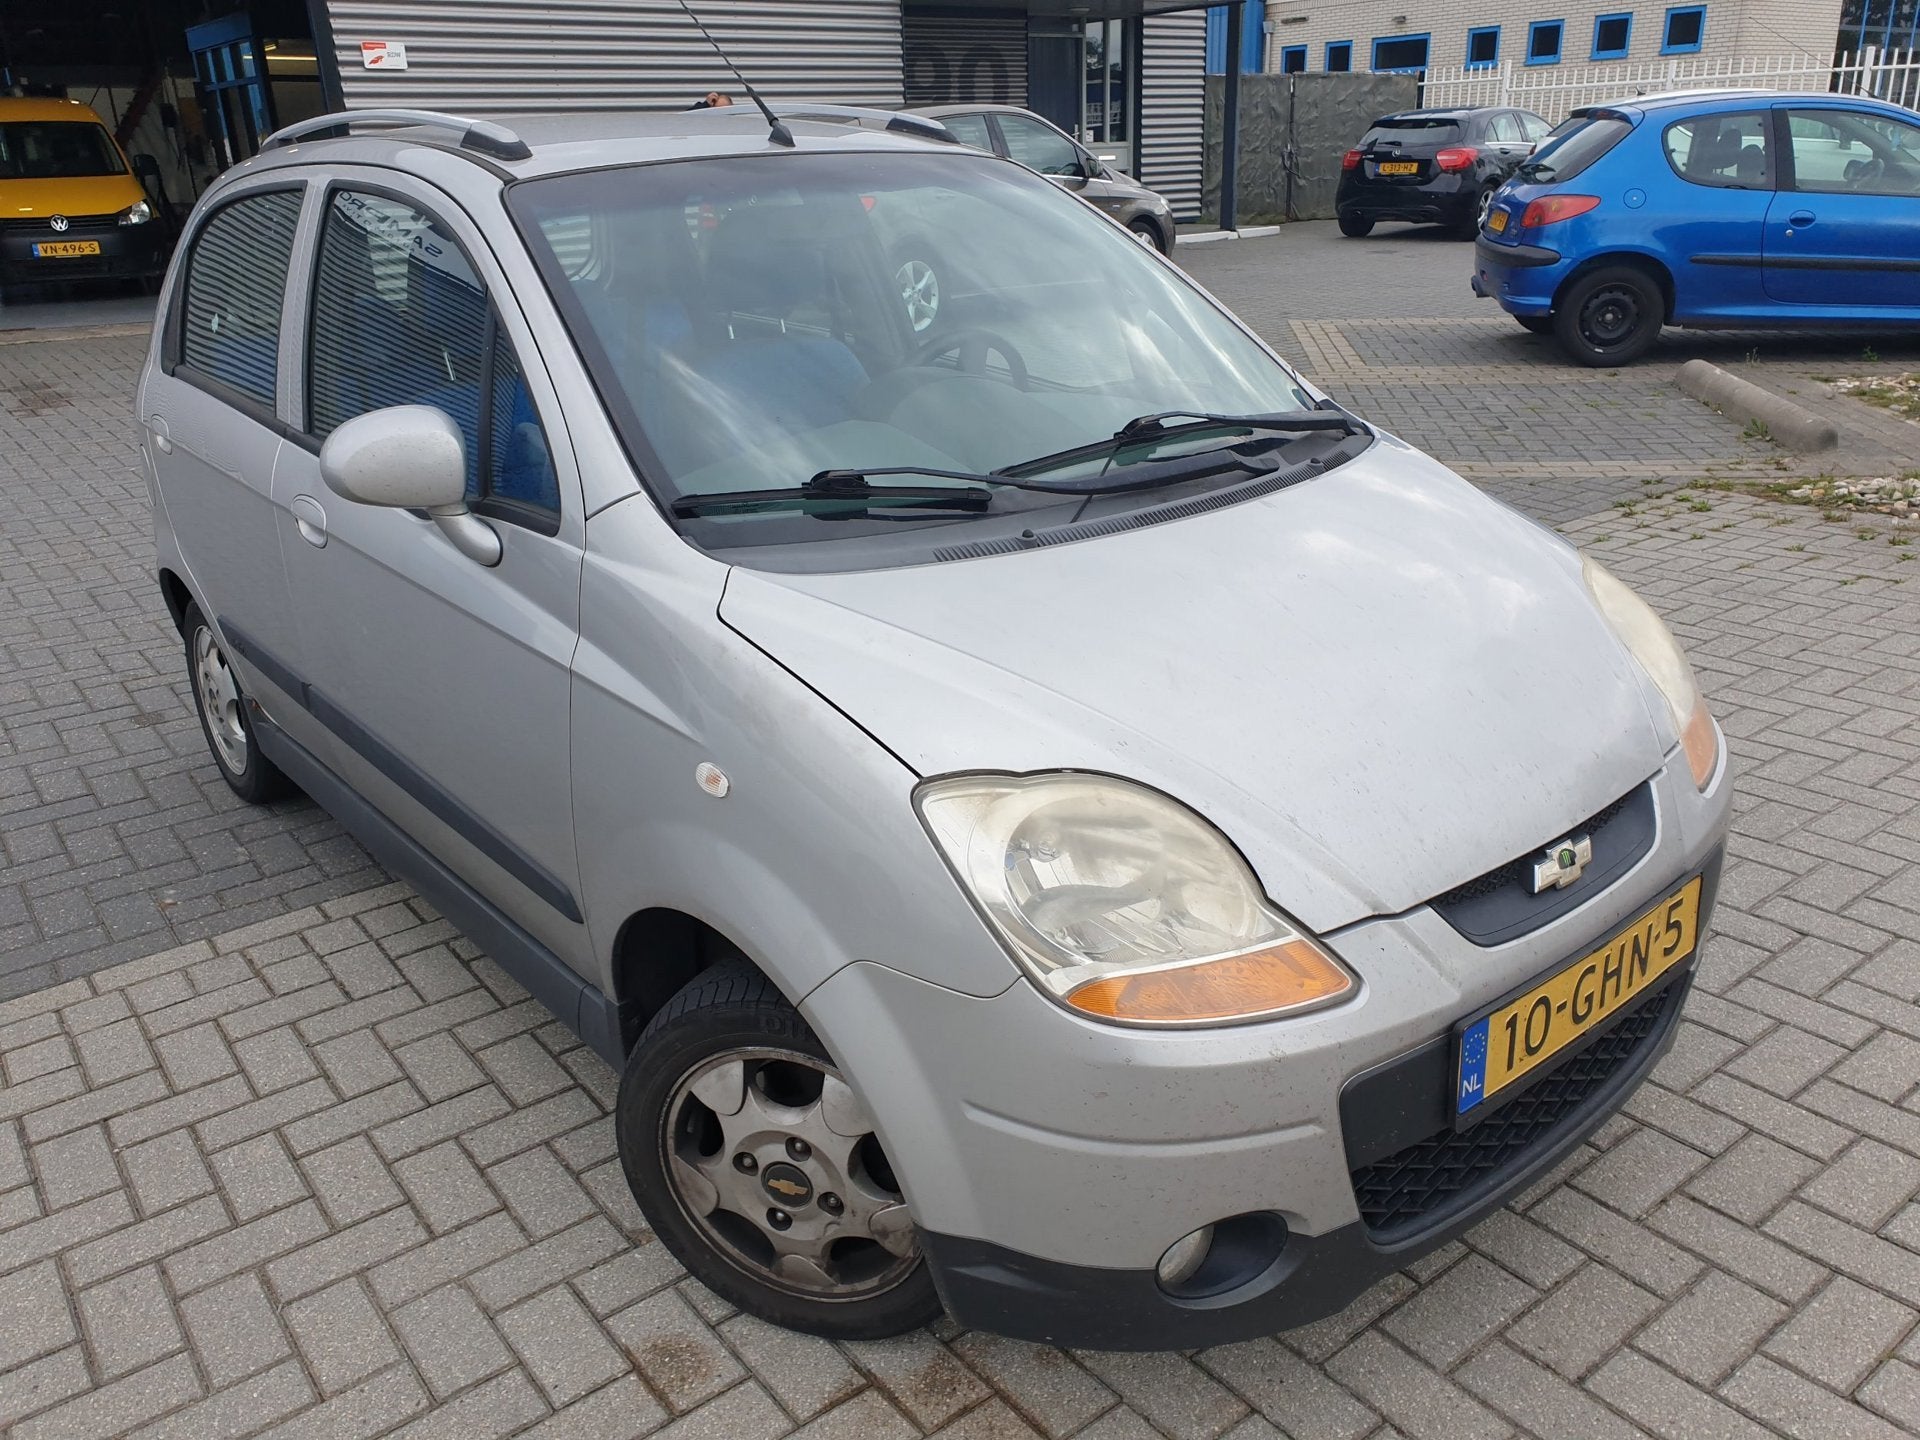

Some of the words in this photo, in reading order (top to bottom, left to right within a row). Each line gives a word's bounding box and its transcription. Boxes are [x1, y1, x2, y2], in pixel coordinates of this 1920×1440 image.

[41, 243, 96, 255] VN-496-S
[1505, 897, 1684, 1072] 10-GHN-5
[1462, 1073, 1482, 1098] NL
